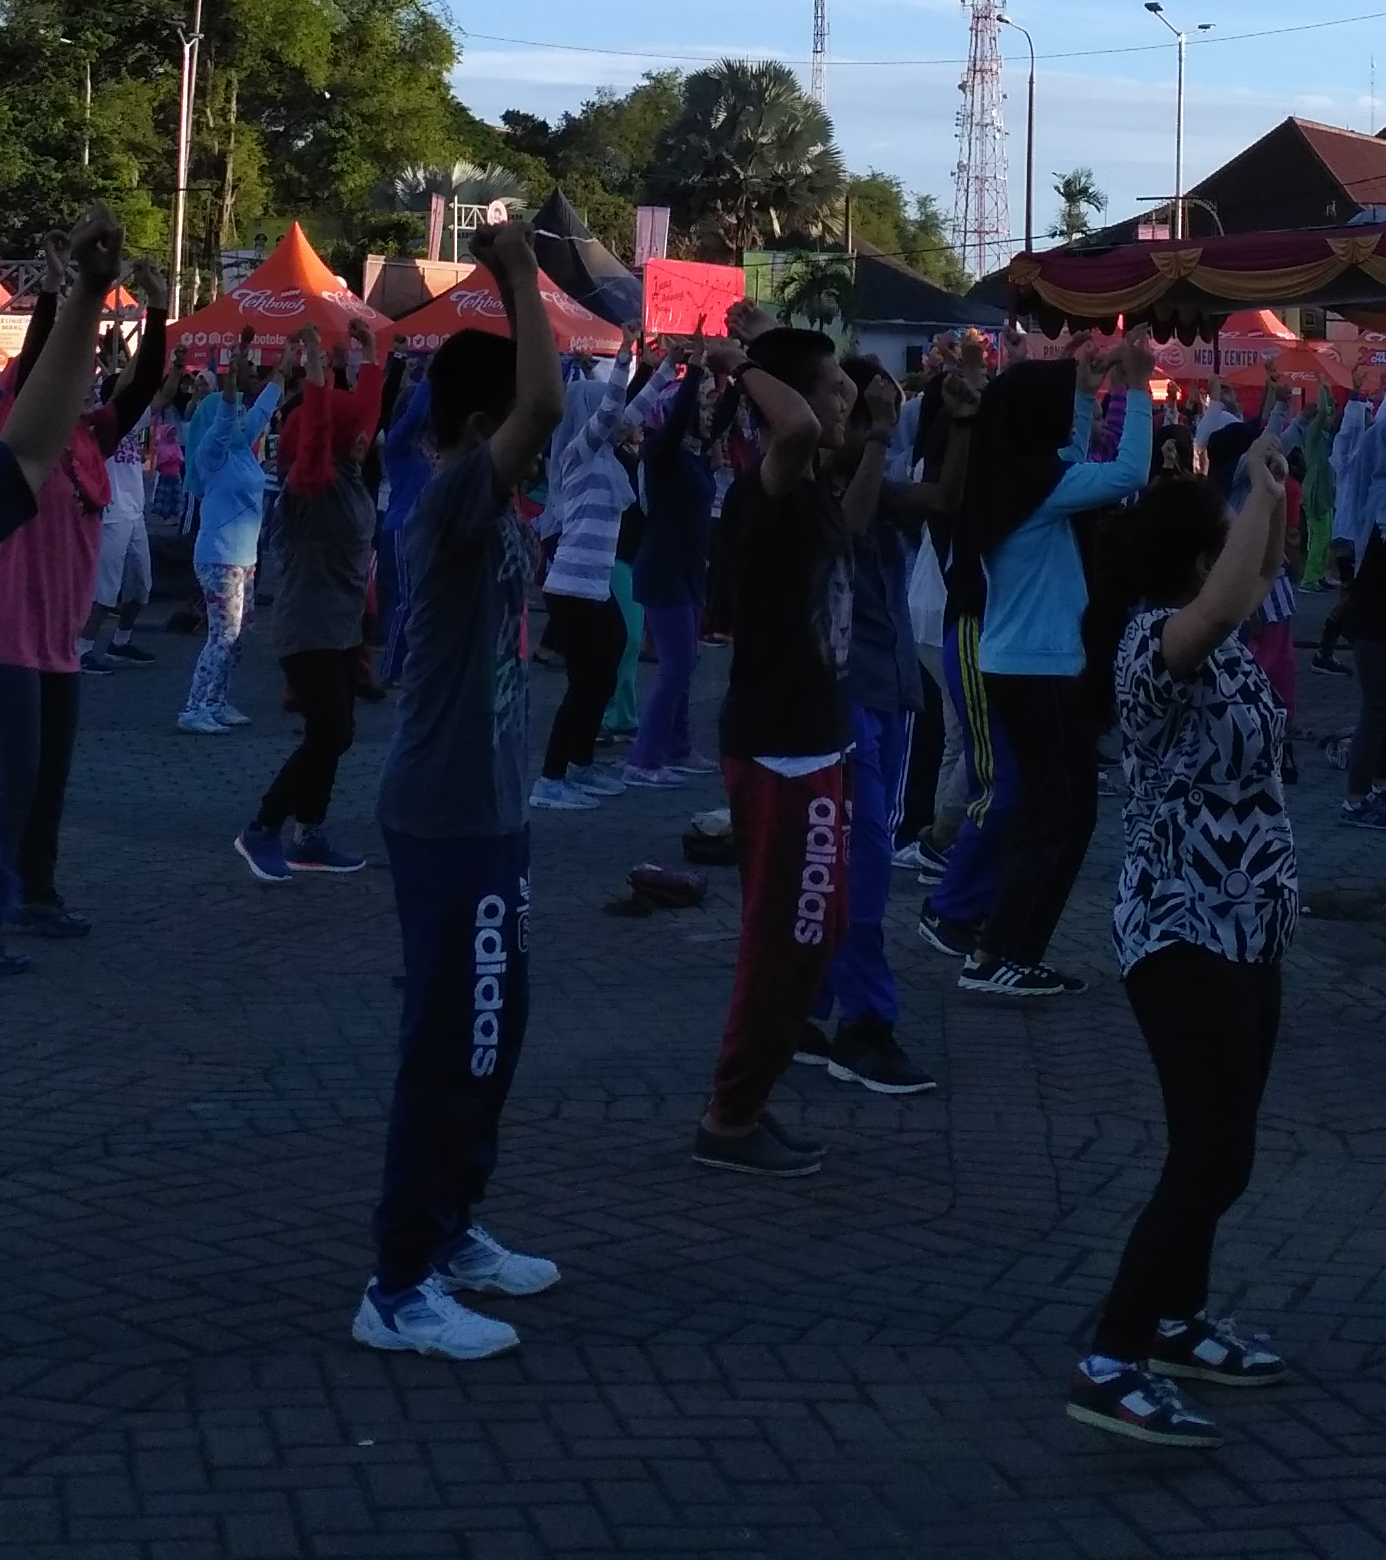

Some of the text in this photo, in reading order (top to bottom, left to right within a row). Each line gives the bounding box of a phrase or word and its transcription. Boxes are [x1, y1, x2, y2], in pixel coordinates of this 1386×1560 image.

[1225, 349, 1258, 367] CENTER
[794, 796, 837, 946] adidas
[470, 894, 507, 1078] adidas
